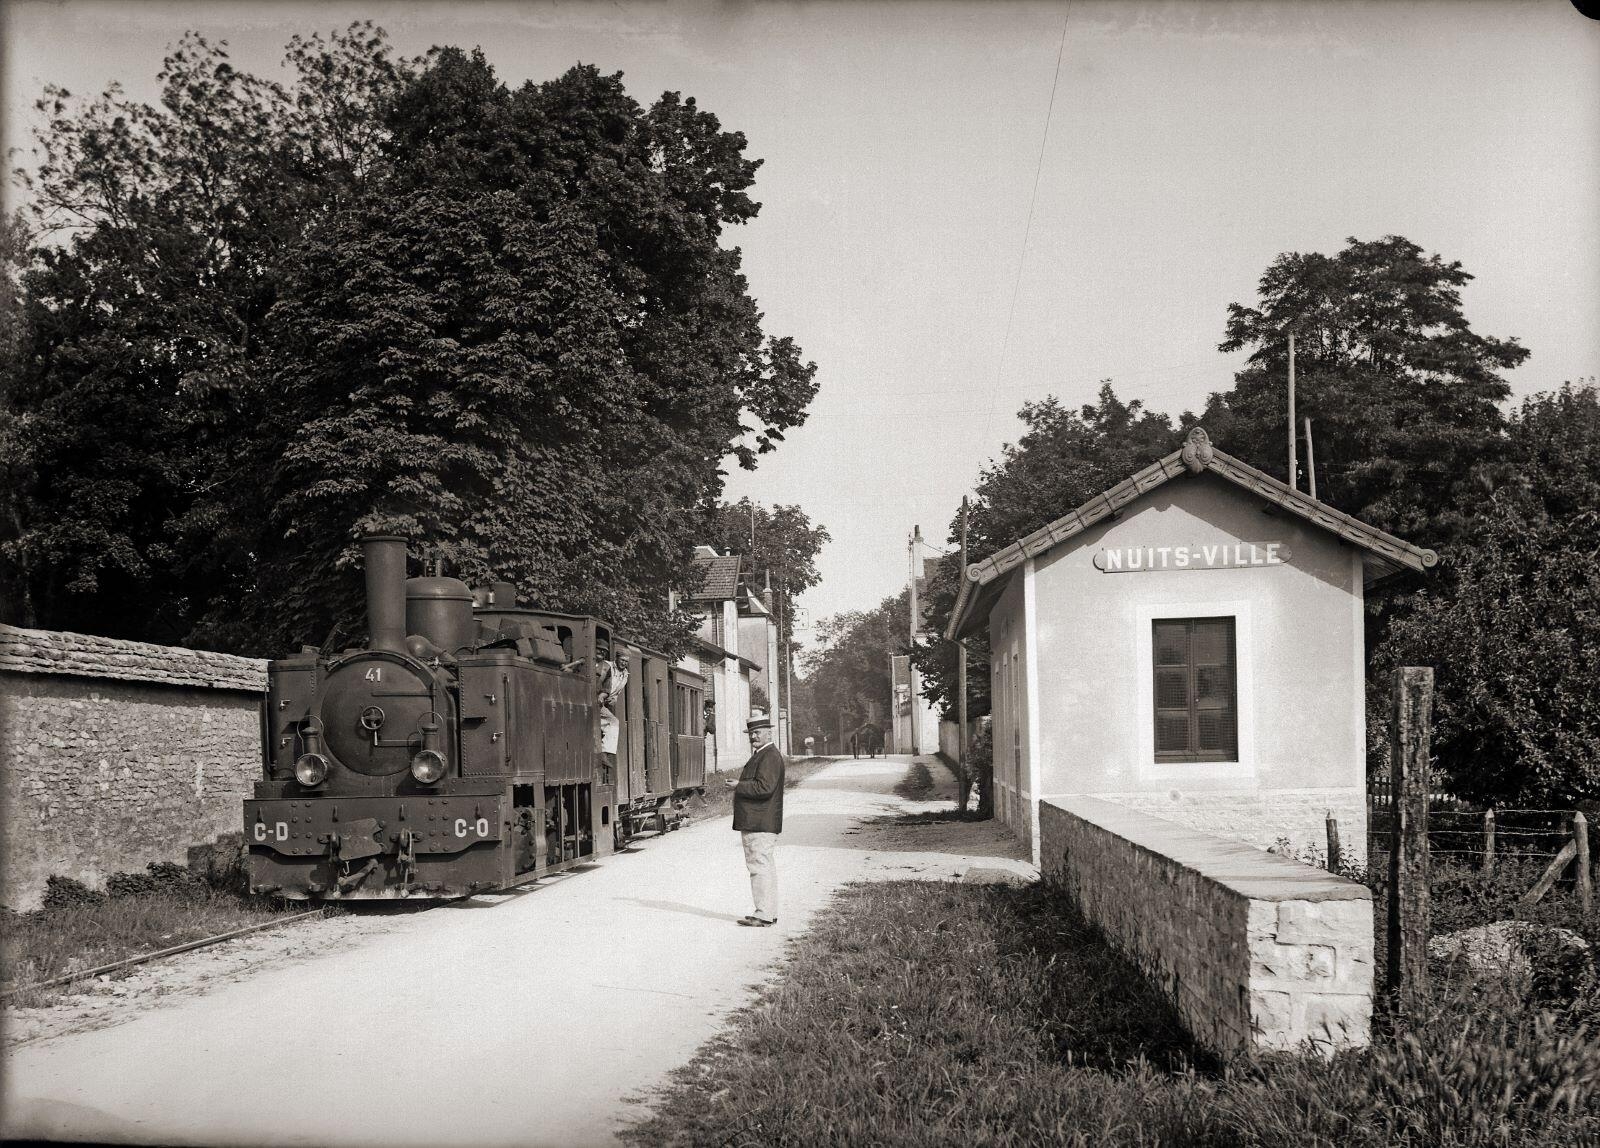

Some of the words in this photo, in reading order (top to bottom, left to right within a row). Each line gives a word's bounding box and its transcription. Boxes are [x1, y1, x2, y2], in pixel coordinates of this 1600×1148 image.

[1107, 543, 1281, 569] NUITS-VILLE
[365, 667, 381, 682] 41
[254, 821, 289, 841] C-D
[454, 818, 489, 838] C-O
